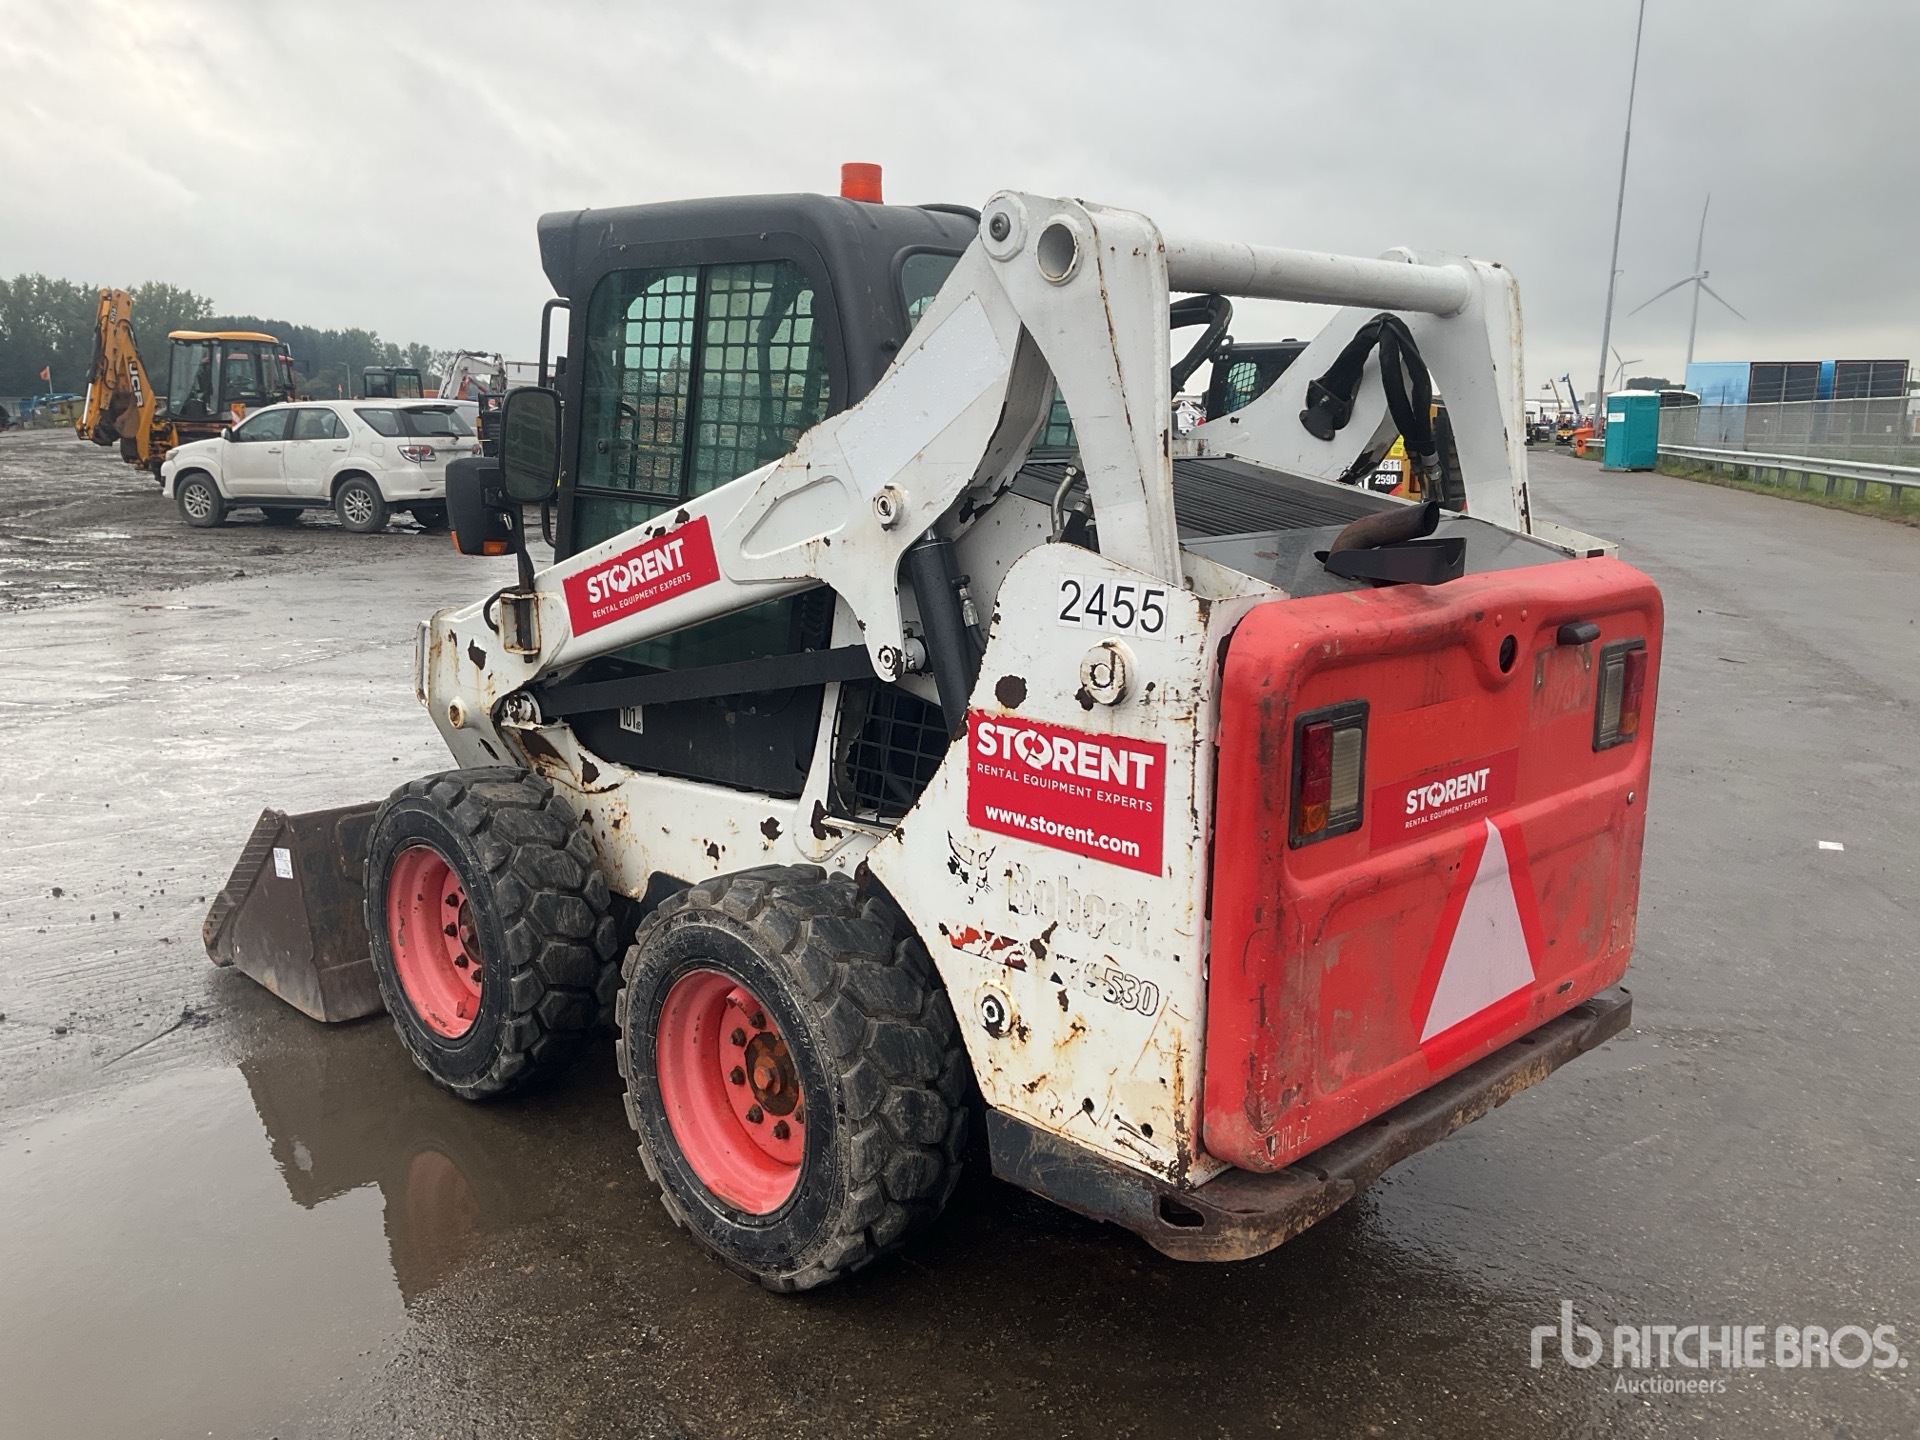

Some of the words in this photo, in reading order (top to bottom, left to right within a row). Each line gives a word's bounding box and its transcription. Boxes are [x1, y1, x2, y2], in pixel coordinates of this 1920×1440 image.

[1374, 473, 1397, 485] 259D
[1378, 460, 1400, 470] 611
[587, 538, 684, 604] STORENT
[592, 603, 618, 619] RENTAL
[619, 587, 657, 609] EQUIPMENT
[660, 572, 691, 592] EXPERTS
[1059, 579, 1167, 633] 2455
[620, 706, 636, 729] 101
[976, 721, 1154, 790] STORENT
[977, 763, 1019, 782] RENTAL
[1023, 774, 1092, 799] EQUIPMENT
[1096, 790, 1153, 812] EXPERTS
[1405, 768, 1490, 814] STORENT
[985, 805, 1140, 857] www.storent.com
[1405, 816, 1428, 829] RENTAL
[1429, 805, 1463, 821] EQUIPMENT
[1464, 796, 1488, 810] EXPERTS
